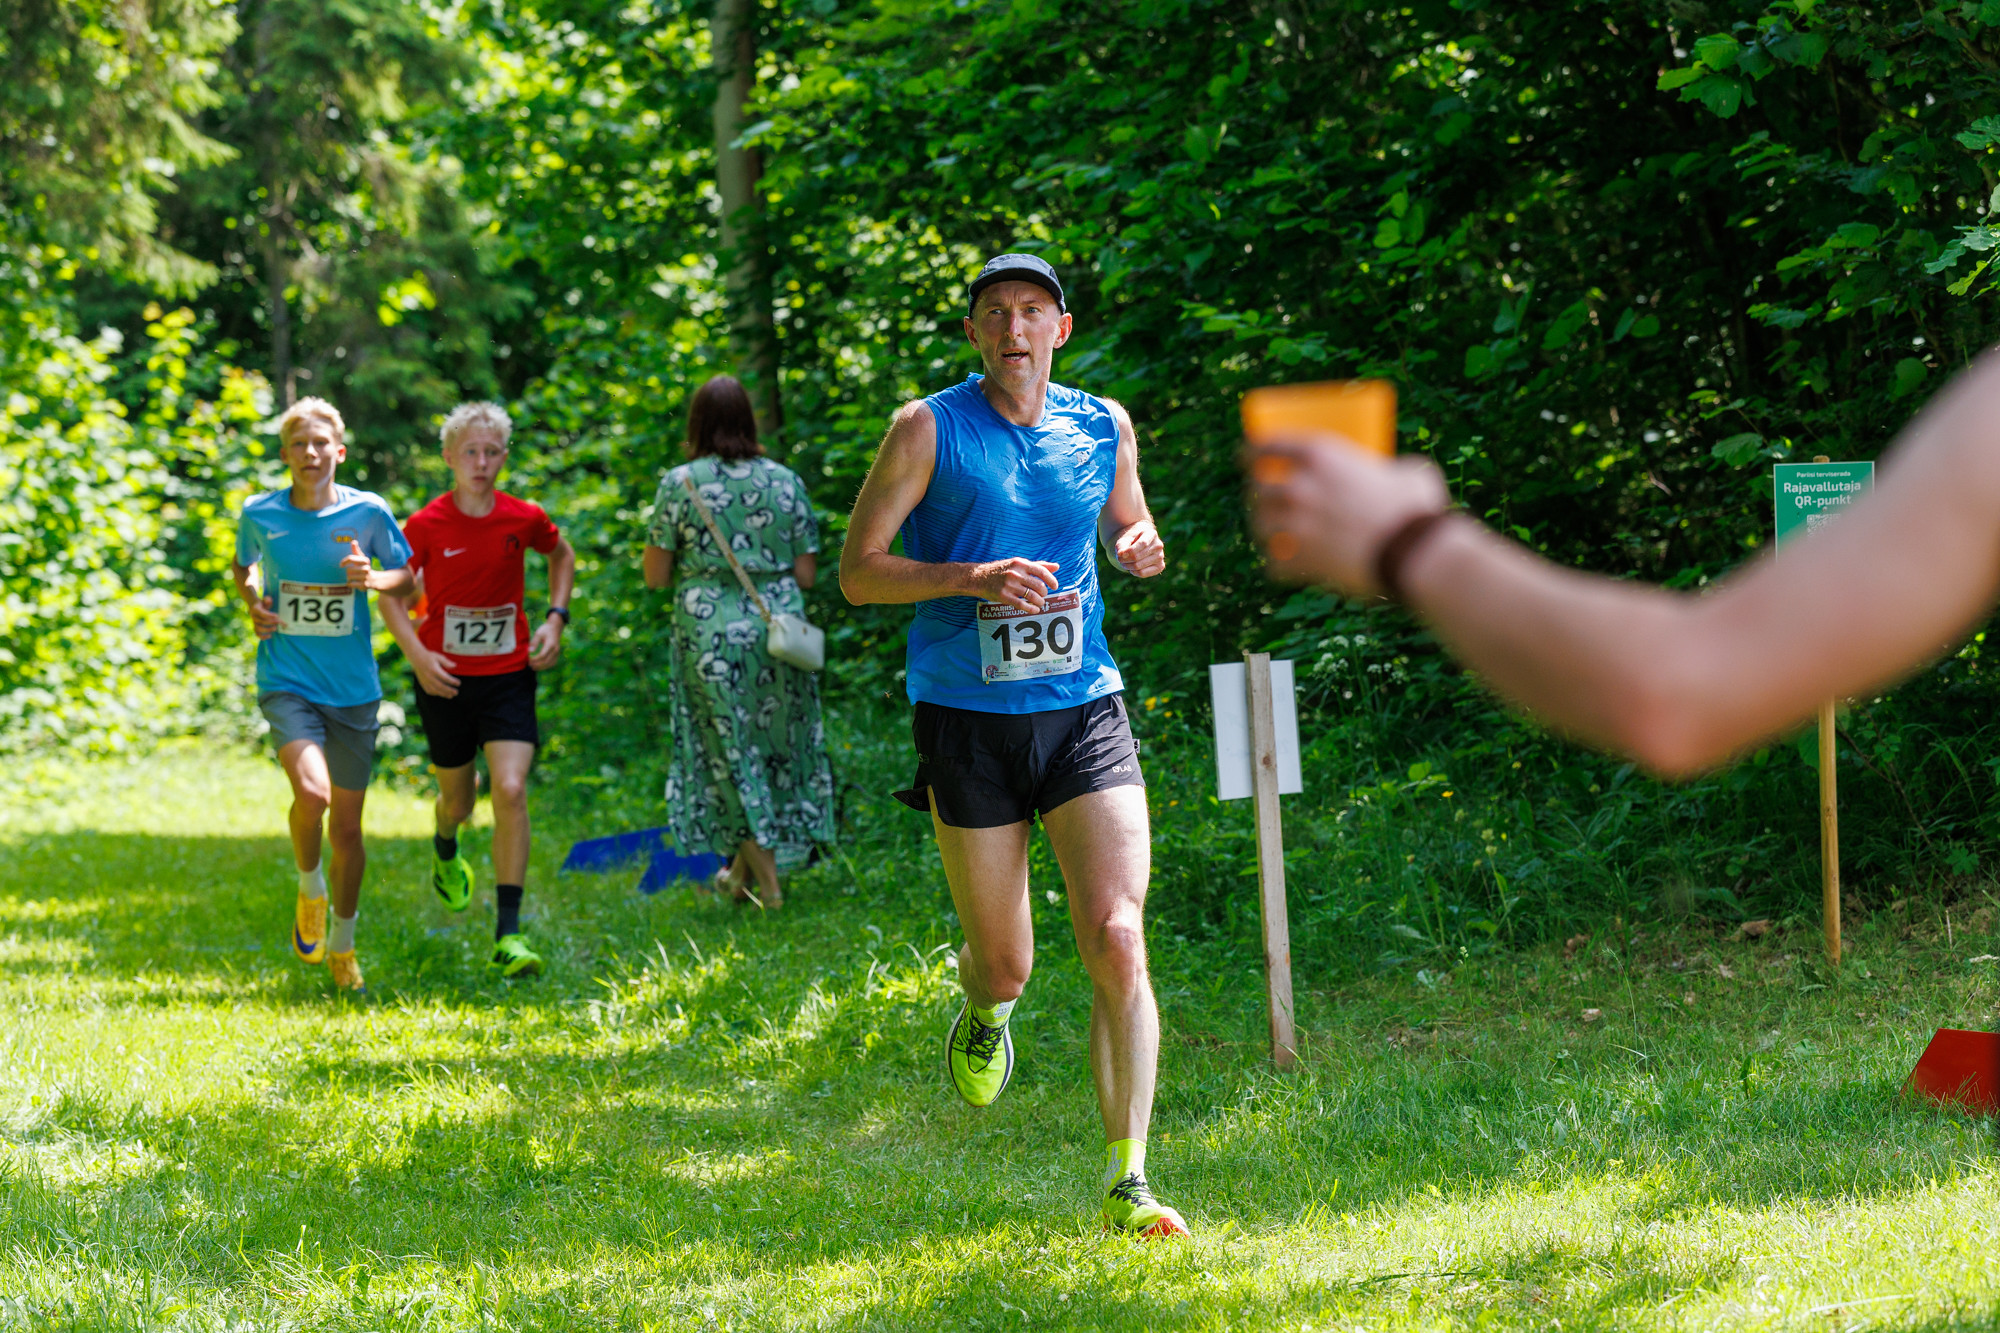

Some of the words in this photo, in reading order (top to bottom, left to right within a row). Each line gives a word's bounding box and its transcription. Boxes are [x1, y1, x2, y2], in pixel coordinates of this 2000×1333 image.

[1816, 470, 1851, 478] terviserada
[1783, 480, 1861, 494] Rajavallutaja
[1795, 494, 1851, 509] QR-punkt
[287, 597, 345, 624] 136
[454, 619, 507, 643] 127
[991, 615, 1074, 662] 130
